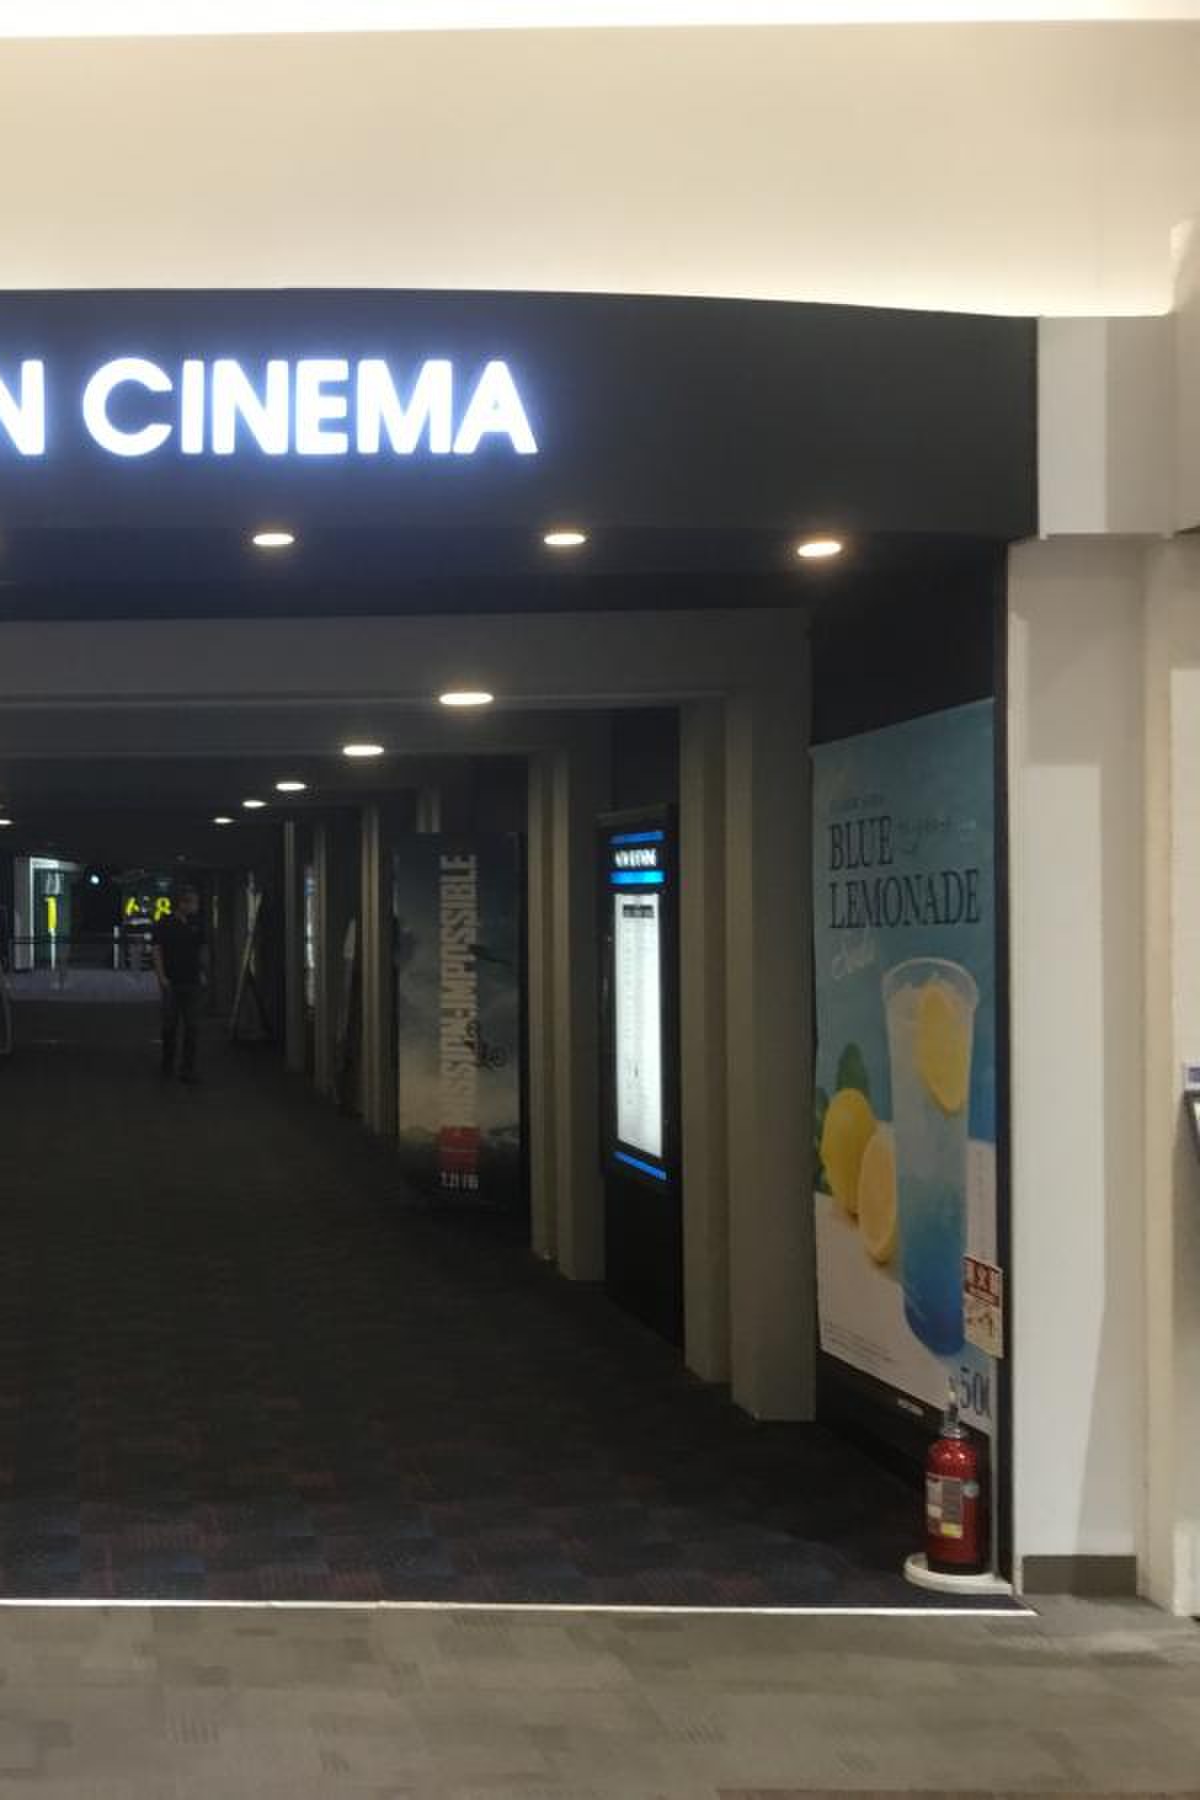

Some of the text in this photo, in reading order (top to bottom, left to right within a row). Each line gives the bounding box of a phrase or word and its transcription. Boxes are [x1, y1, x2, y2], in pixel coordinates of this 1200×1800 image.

[81, 356, 538, 458] CINEMA
[828, 815, 894, 871] BLUE
[828, 868, 981, 929] LEMONADE
